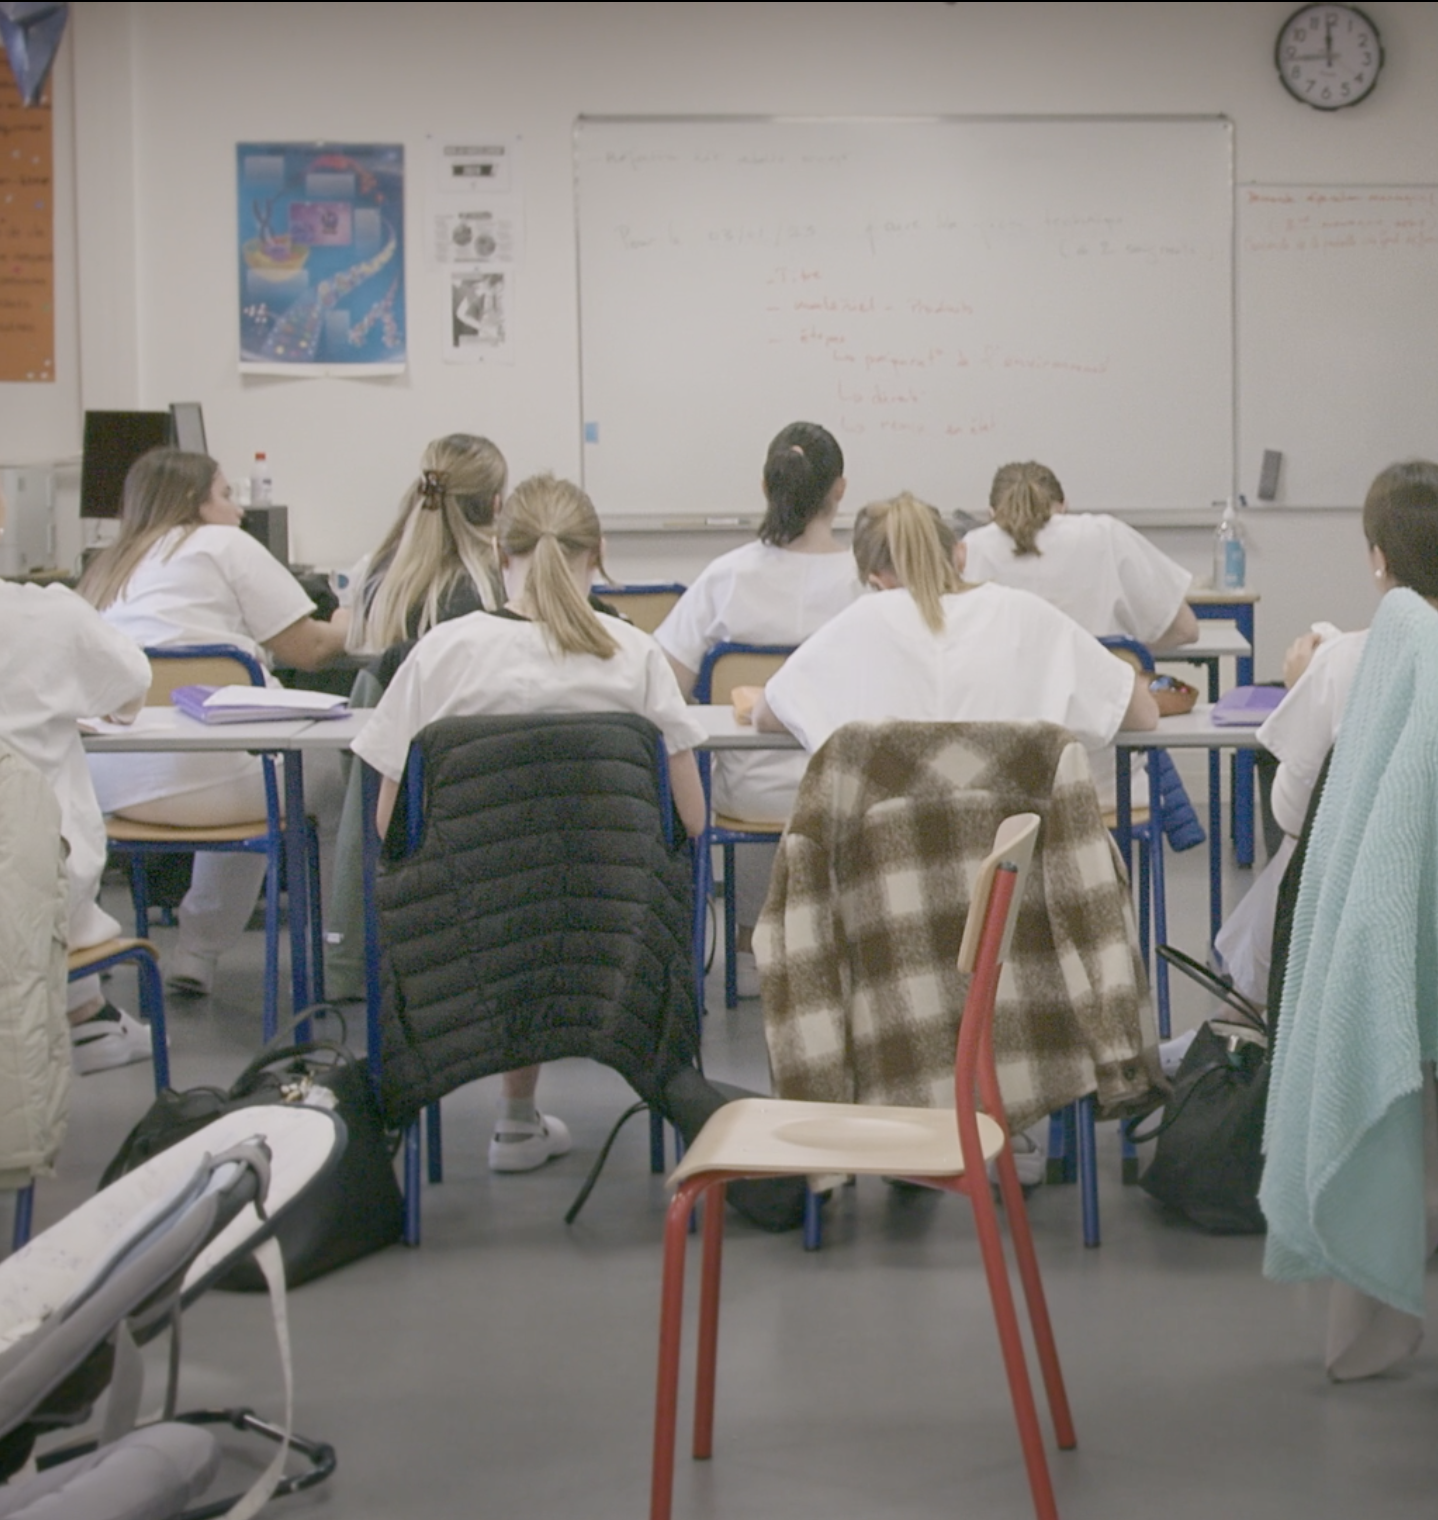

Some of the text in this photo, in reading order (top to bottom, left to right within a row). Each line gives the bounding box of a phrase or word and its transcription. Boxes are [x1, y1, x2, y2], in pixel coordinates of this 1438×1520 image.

[1348, 19, 1354, 33] 1
[1293, 27, 1307, 43] 10
[1358, 32, 1368, 48] 2
[1286, 46, 1296, 61] 9
[1361, 51, 1372, 66] 3
[1290, 64, 1301, 80] 8
[1354, 72, 1364, 84] 4
[1305, 79, 1317, 94] 7
[1321, 86, 1331, 100] 6
[1340, 81, 1351, 97] 5
